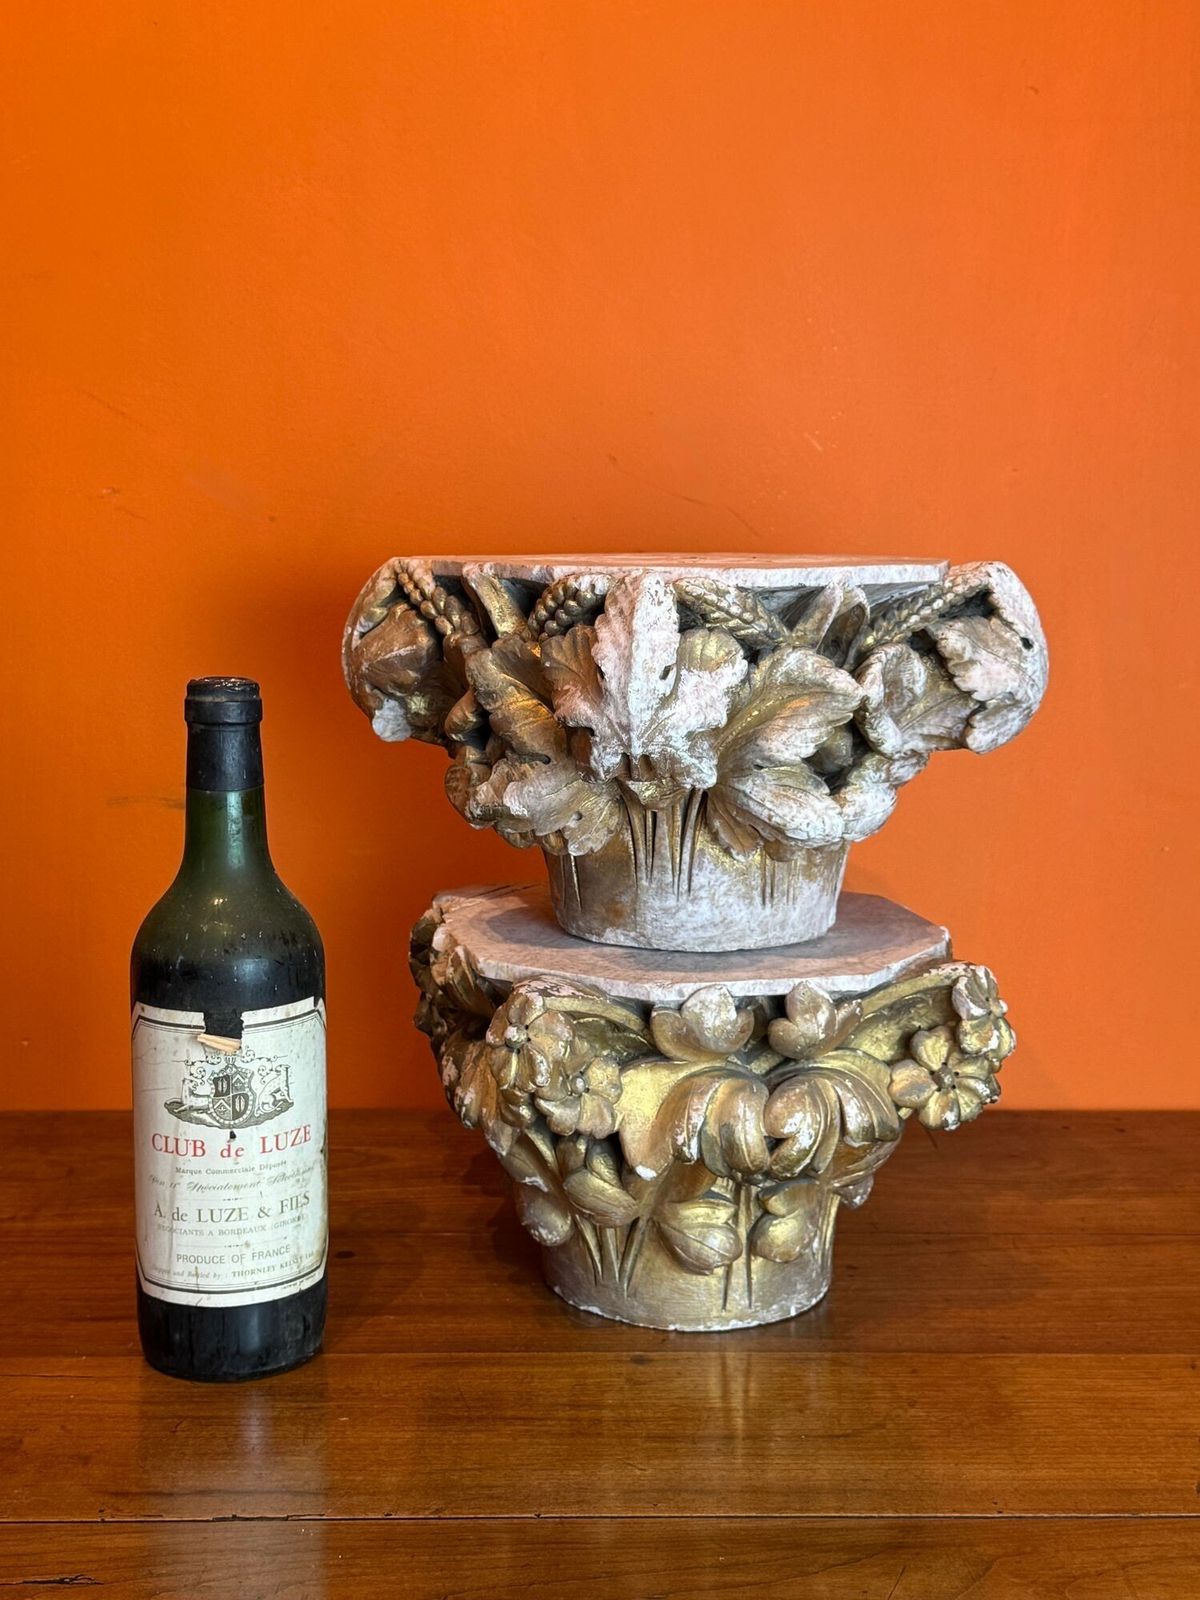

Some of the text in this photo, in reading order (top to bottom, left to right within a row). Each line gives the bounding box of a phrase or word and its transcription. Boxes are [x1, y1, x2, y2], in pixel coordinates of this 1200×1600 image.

[152, 1124, 312, 1158] CLUB de LUZE
[175, 1166, 202, 1176] Marque
[205, 1165, 255, 1175] Commerciale
[171, 1206, 189, 1222] de
[197, 1206, 249, 1224] LUZE
[257, 1202, 272, 1219] &
[279, 1191, 311, 1215] FILS
[218, 1224, 267, 1237] BORDEAUX
[176, 1244, 291, 1265] PRODUCE OF FRANCE
[188, 1270, 211, 1279] Botled
[231, 1264, 276, 1278] THORNLEY
